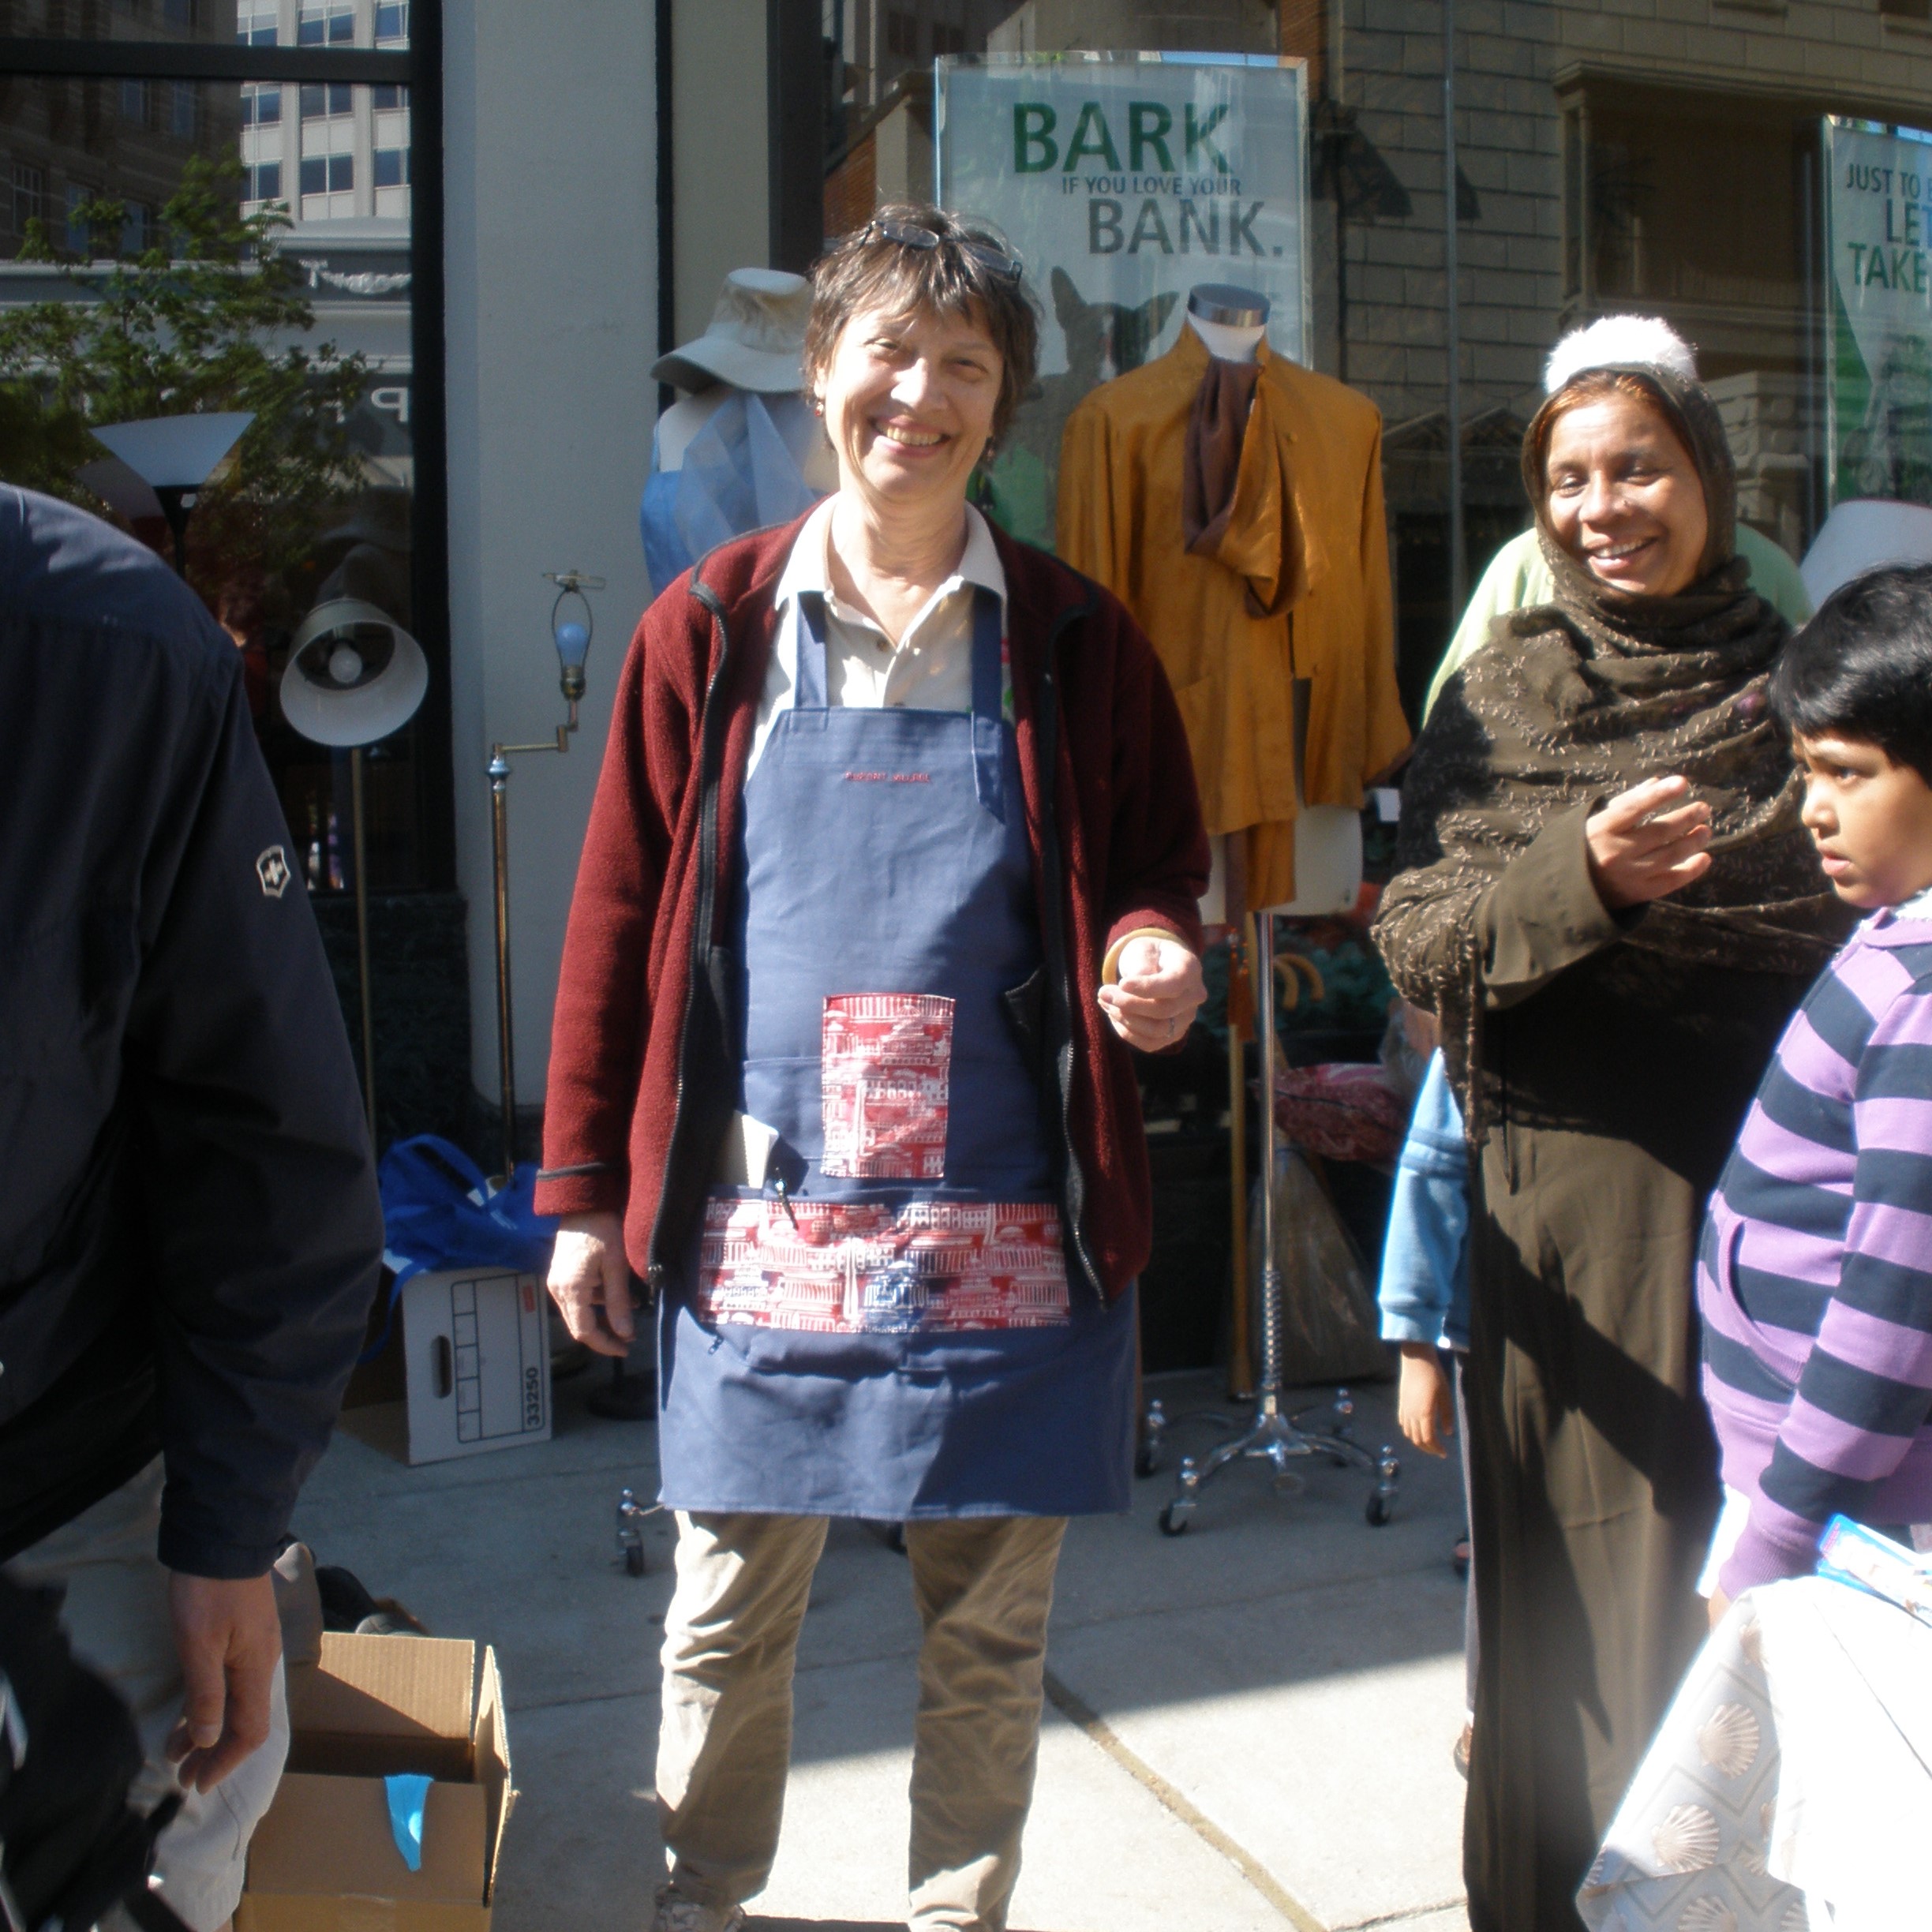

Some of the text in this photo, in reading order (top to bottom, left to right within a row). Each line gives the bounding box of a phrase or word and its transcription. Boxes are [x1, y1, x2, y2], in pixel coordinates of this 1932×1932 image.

[1014, 100, 1233, 174] BARK
[1062, 176, 1241, 197] IF YOU LOVE YOUR
[1847, 163, 1893, 194] JUST
[1900, 171, 1921, 199] TO
[1088, 198, 1283, 257] BANK.
[1847, 241, 1928, 294] TAKE
[526, 1368, 540, 1426] 33250
